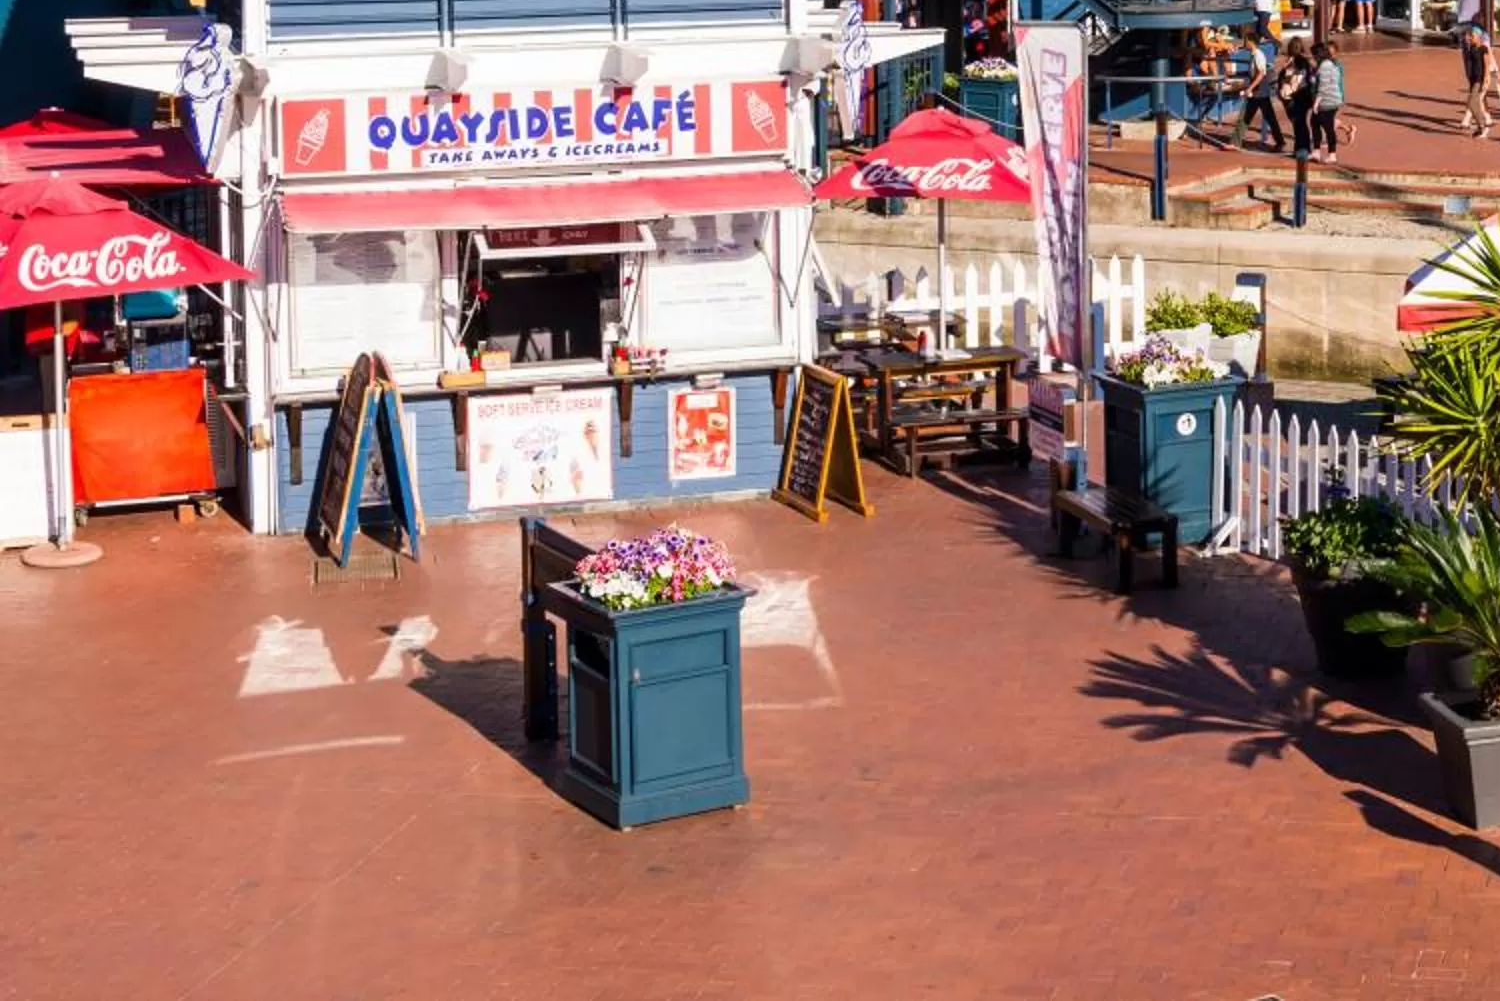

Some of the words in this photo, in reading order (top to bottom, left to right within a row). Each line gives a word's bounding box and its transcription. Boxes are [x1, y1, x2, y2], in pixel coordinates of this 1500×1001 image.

[368, 105, 575, 150] QUAYSIDE
[593, 90, 696, 136] CAFÉ
[429, 151, 475, 164] TAKE
[481, 148, 539, 161] AWAYS
[565, 141, 661, 157] ICECREAMS
[851, 158, 994, 192] Coca-Cola
[18, 231, 181, 292] Coca-Cola
